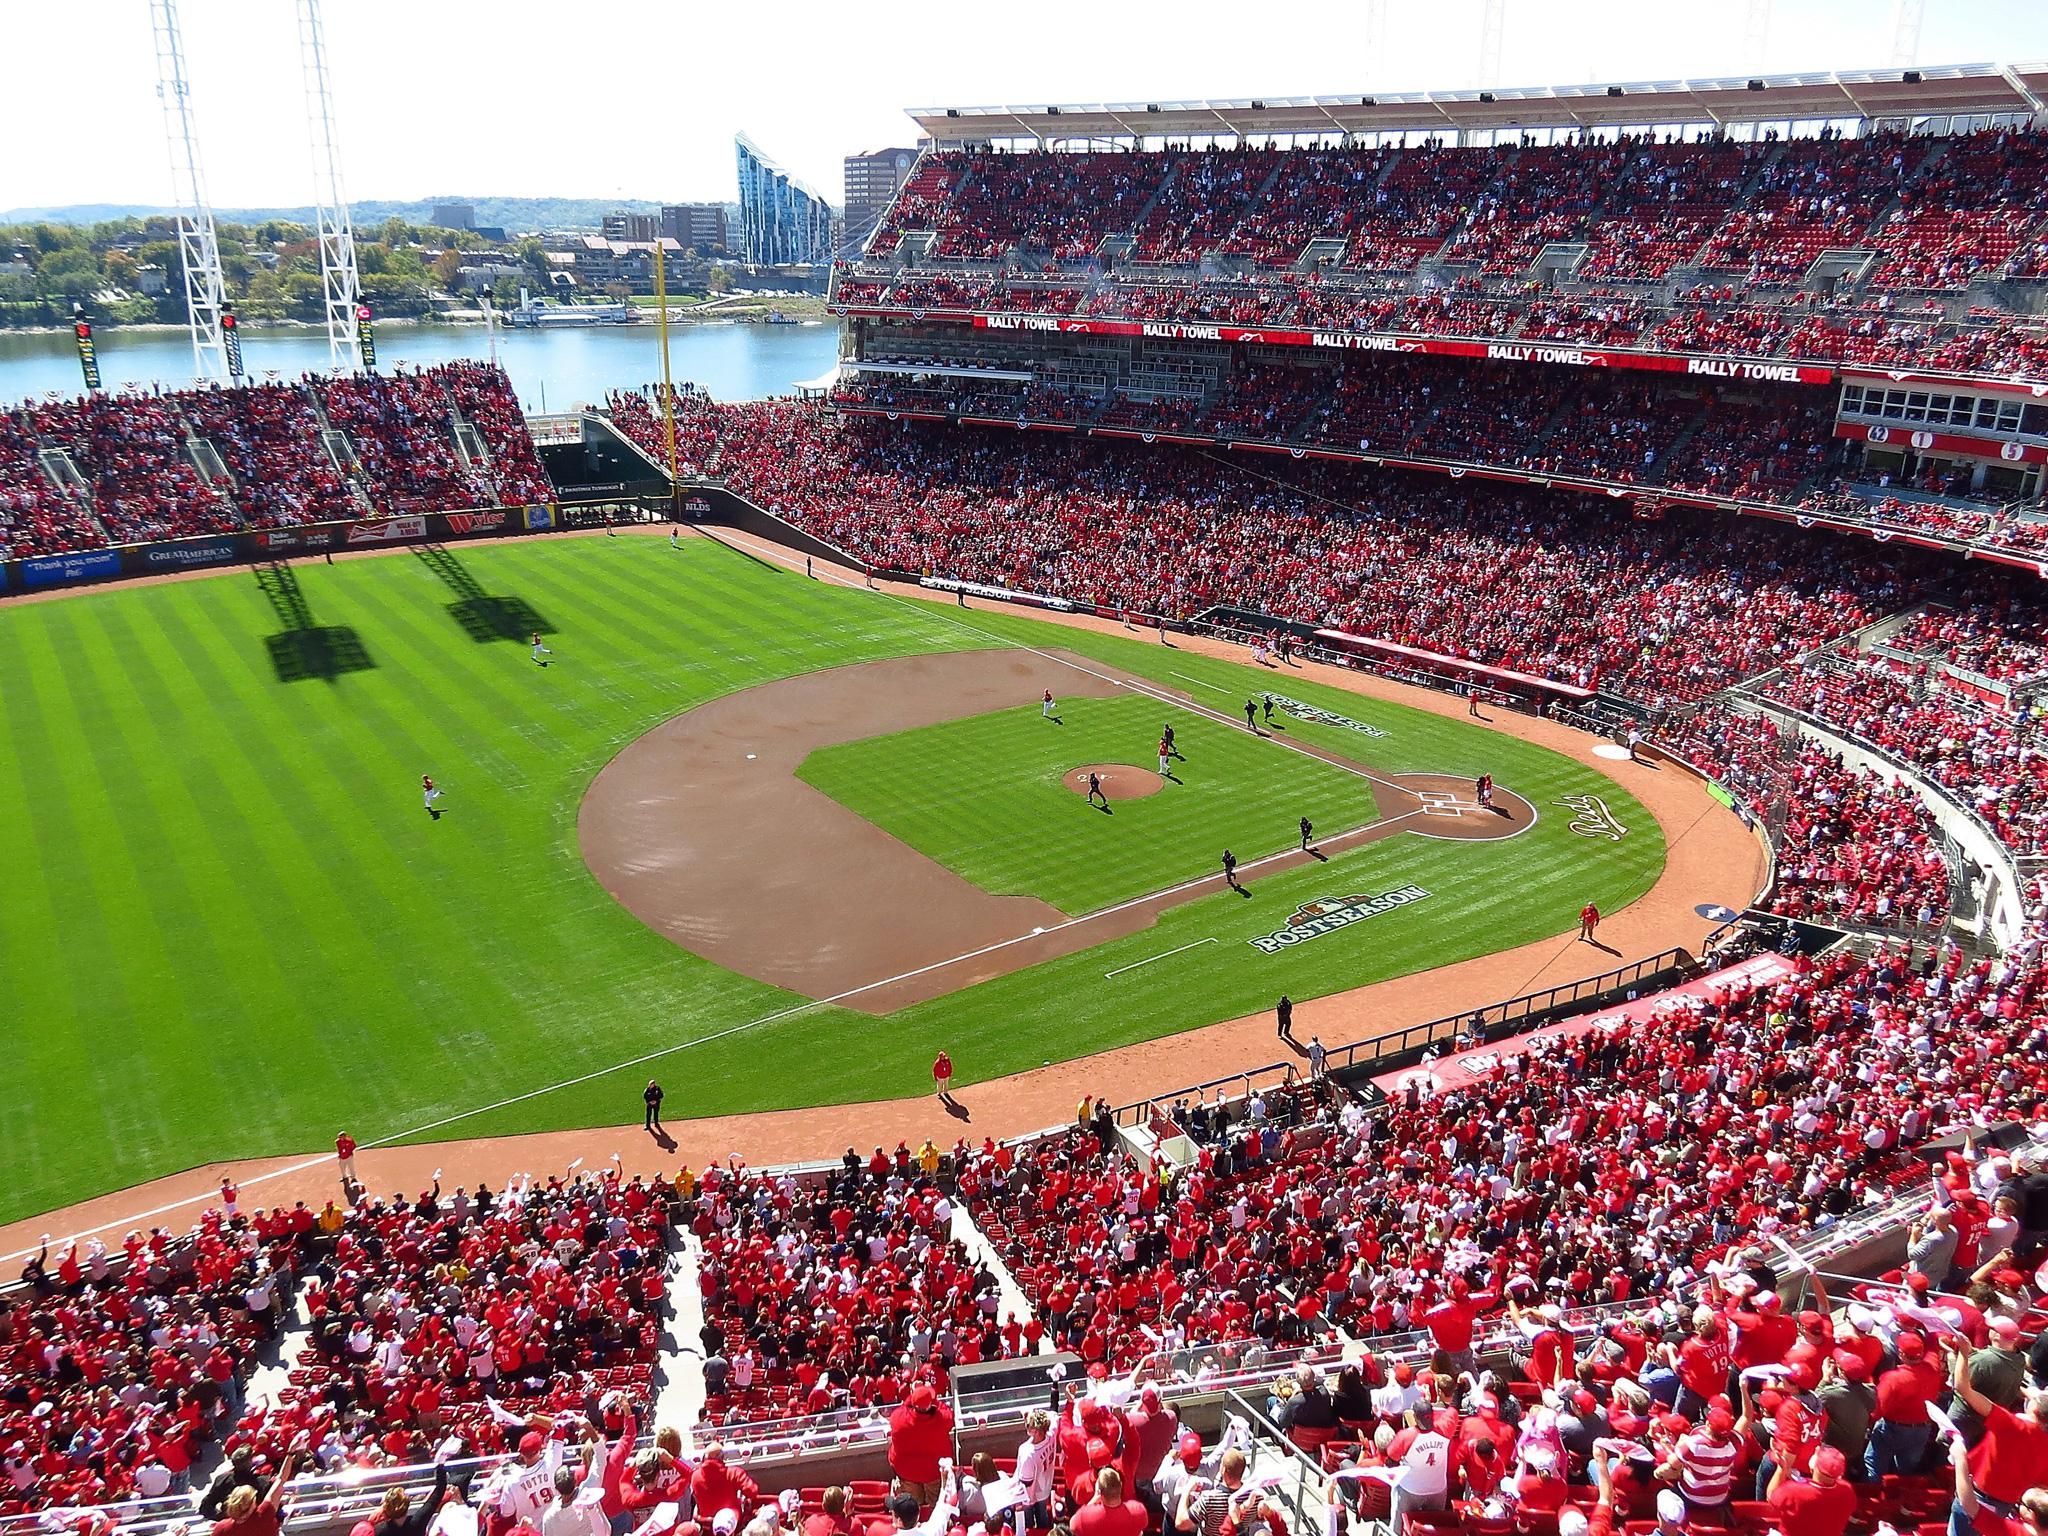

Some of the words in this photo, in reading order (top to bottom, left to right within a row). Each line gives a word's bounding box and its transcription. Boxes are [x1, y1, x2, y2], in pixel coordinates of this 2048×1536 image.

[987, 316, 1023, 330] RALLY
[1023, 318, 1061, 332] TOWEL
[1143, 324, 1180, 338] RALLY
[1180, 326, 1221, 340] TOWEL
[1312, 333, 1352, 348] RALLY
[1354, 337, 1399, 351] TOWEL
[1488, 345, 1533, 361] RALLY
[1535, 349, 1585, 365] TOWEL
[1688, 360, 1740, 377] RALLY
[1742, 363, 1801, 383] TOWEL
[2007, 443, 2018, 459] 5
[685, 502, 711, 512] NLDS
[445, 511, 506, 534] Wyler
[936, 580, 1012, 600] POSSEASON
[1252, 884, 1428, 954] POSTSEASON
[1703, 1342, 1728, 1359] VOTTO
[1711, 1356, 1728, 1374] 19
[1800, 1419, 1821, 1443] 54
[1415, 1440, 1444, 1454] PHILLIPS
[1425, 1452, 1436, 1467] 4
[520, 1472, 549, 1491] VOTTO
[528, 1487, 555, 1509] 19
